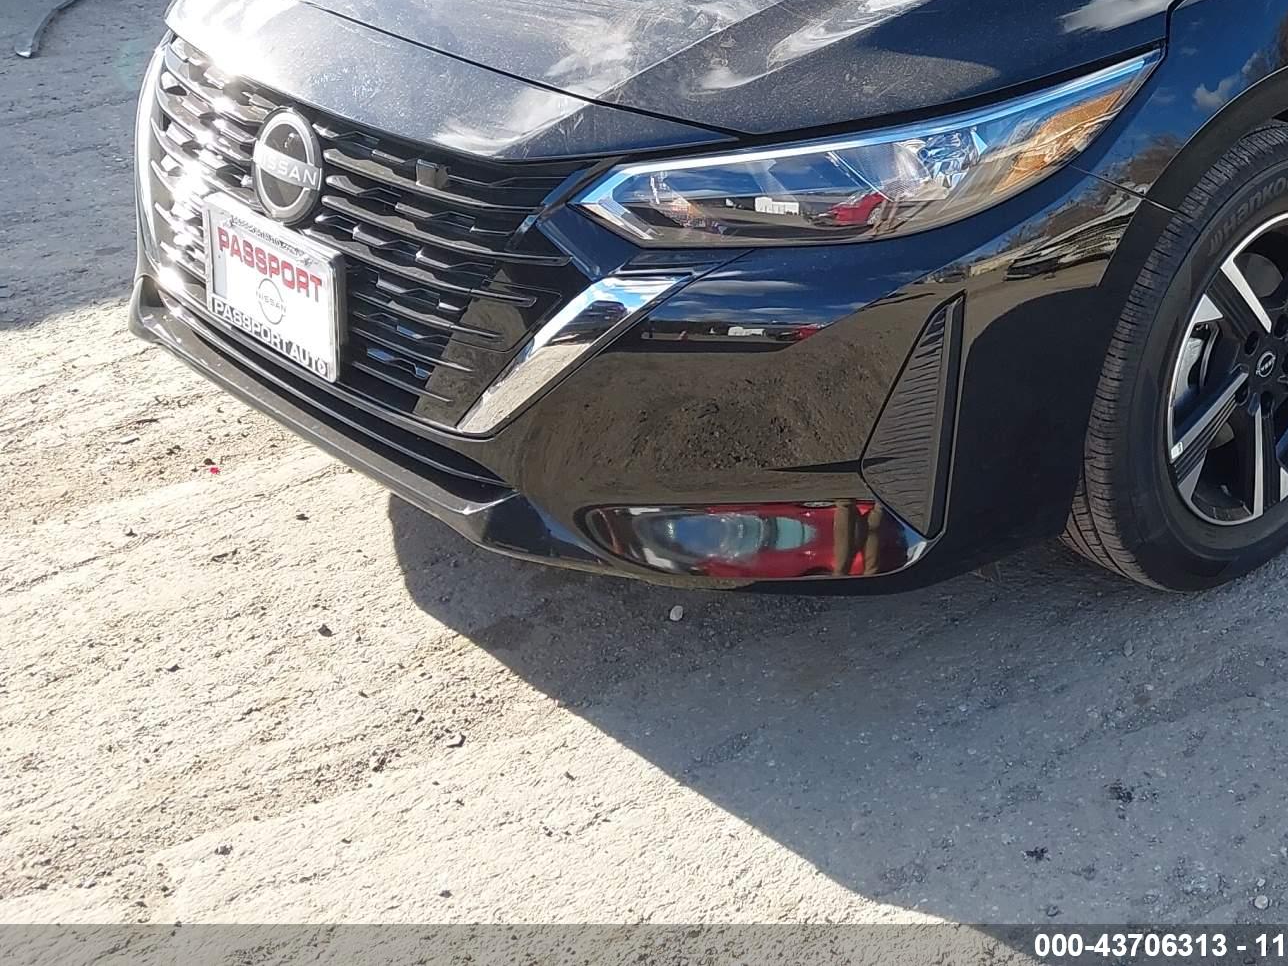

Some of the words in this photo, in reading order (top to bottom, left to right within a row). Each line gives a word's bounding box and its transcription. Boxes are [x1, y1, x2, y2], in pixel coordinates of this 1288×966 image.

[258, 146, 318, 186] ISSAN
[217, 226, 323, 303] PASSPORT
[213, 296, 289, 353] PASSPORT
